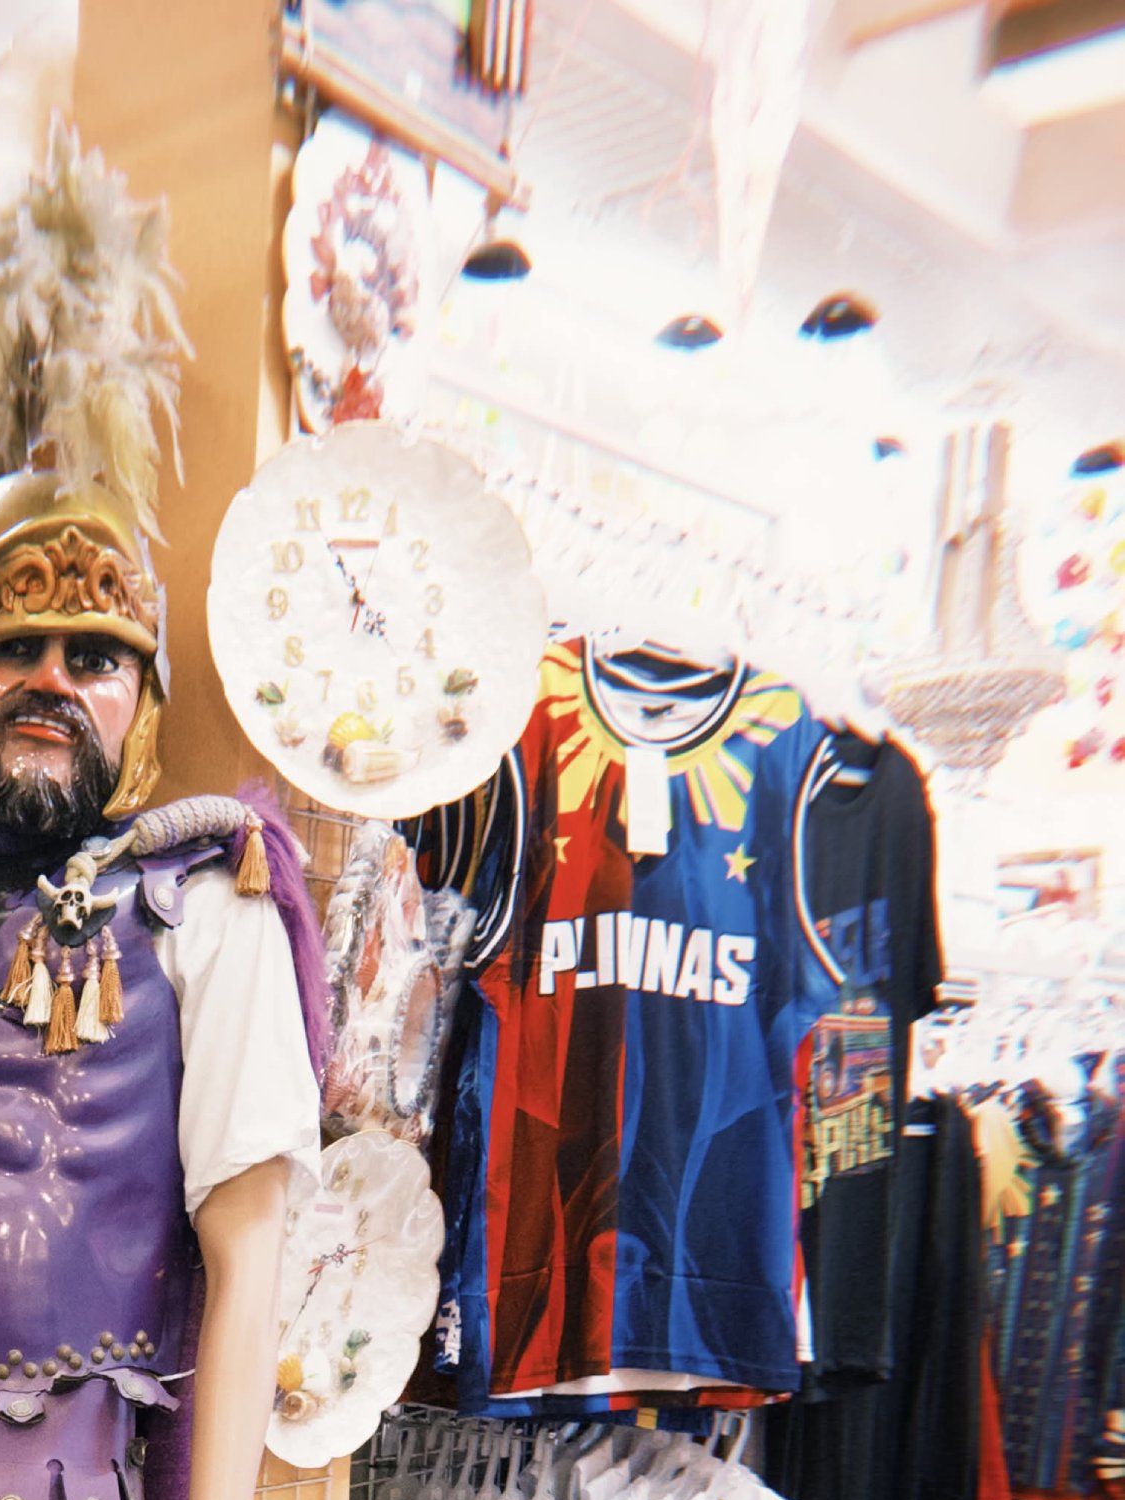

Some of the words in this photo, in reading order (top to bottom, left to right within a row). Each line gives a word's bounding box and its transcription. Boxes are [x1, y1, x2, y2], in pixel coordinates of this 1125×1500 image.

[295, 498, 321, 531] 11
[339, 486, 372, 522] 12
[383, 500, 399, 536] 1
[271, 541, 305, 574] 10
[408, 539, 429, 572] 2
[267, 587, 289, 621] 9
[424, 583, 444, 615] 3
[283, 636, 305, 668] 8
[416, 627, 436, 660] 4
[315, 669, 333, 702] 7
[396, 666, 415, 697] 5
